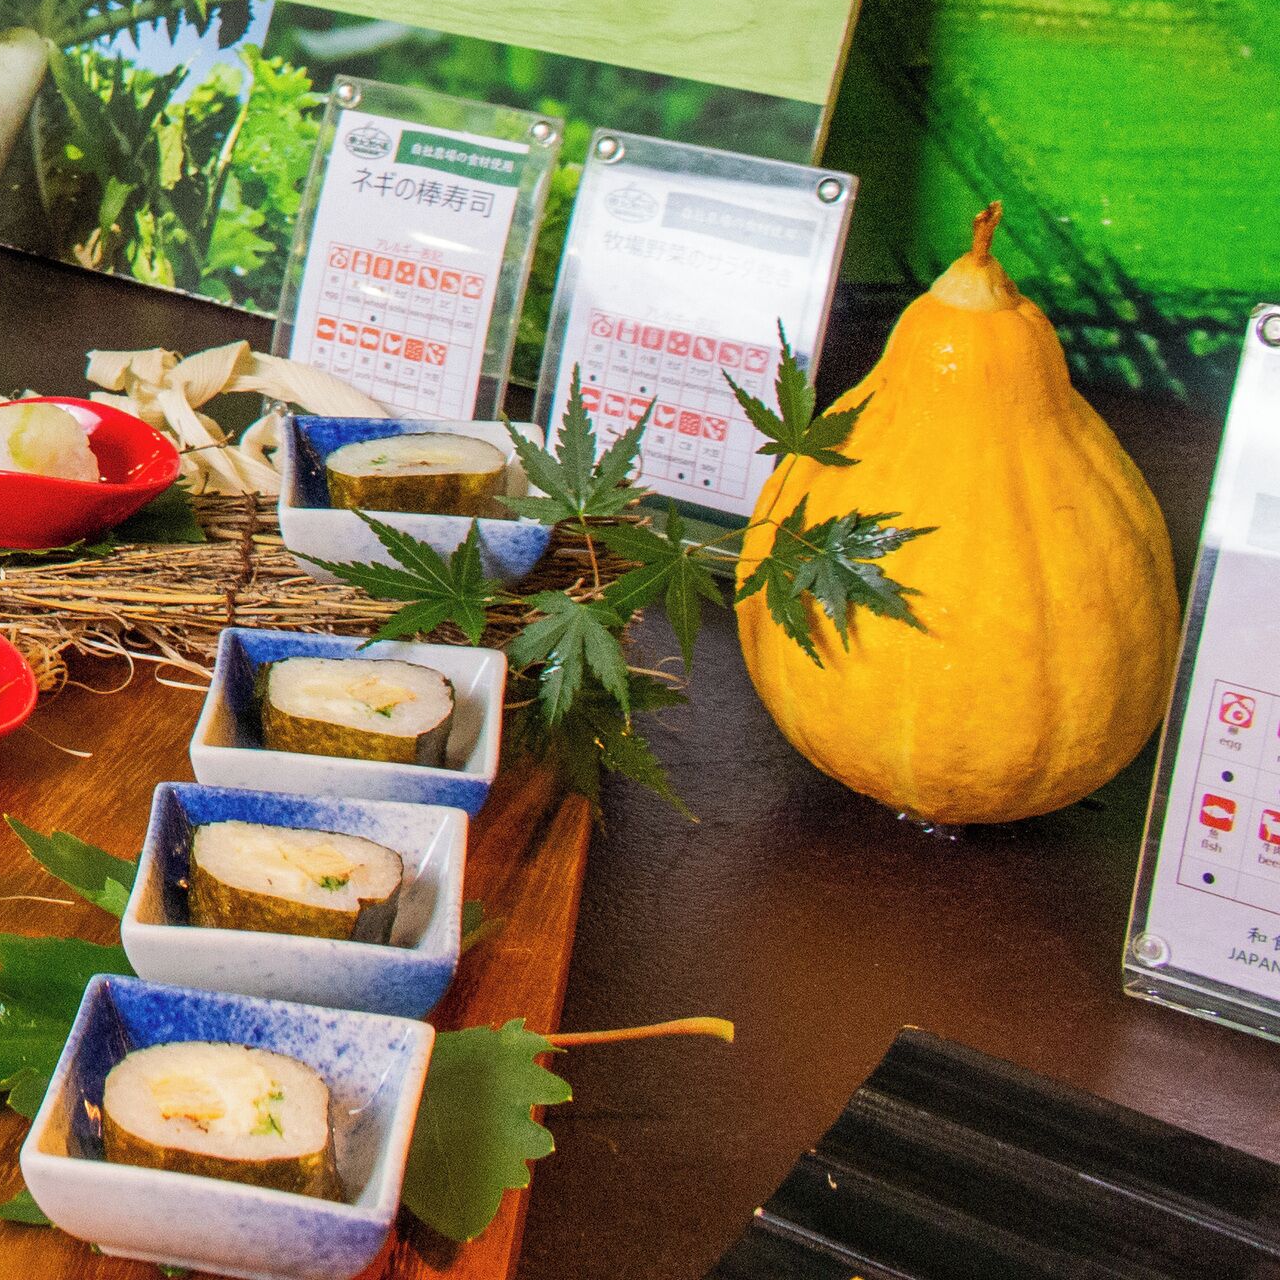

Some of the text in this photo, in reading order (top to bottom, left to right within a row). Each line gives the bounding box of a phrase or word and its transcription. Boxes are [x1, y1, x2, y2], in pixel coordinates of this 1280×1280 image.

[351, 167, 496, 218] ネギの棒寿司
